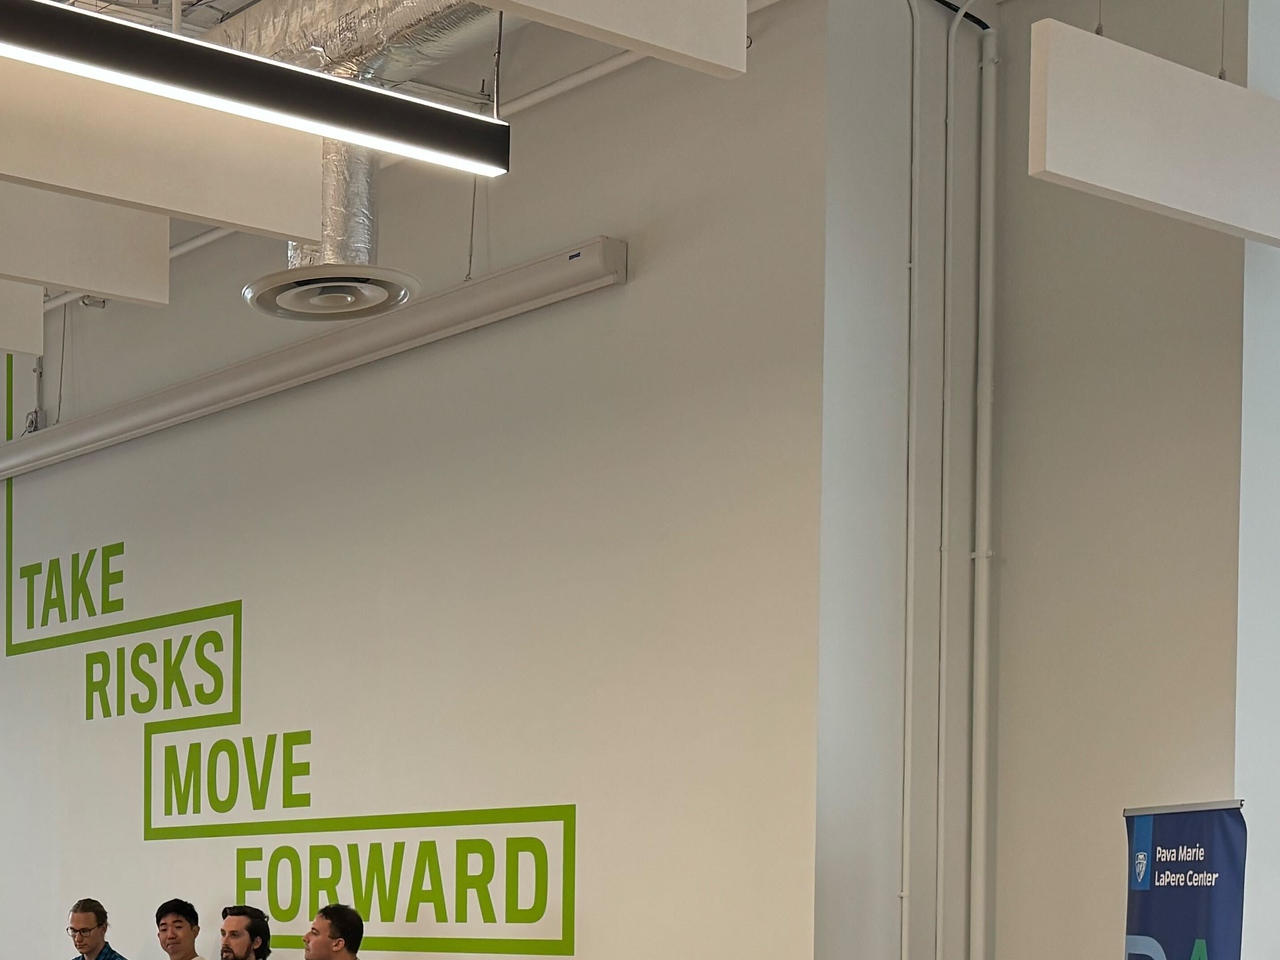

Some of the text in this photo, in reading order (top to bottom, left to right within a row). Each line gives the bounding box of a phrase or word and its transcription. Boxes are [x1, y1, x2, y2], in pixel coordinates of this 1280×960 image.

[20, 541, 125, 629] TAKE
[85, 631, 224, 720] RISKS
[164, 730, 312, 816] MOVE
[236, 836, 549, 924] FORWARD
[1155, 870, 1219, 887] LaPere Center
[1156, 843, 1205, 862] Pava Marie
